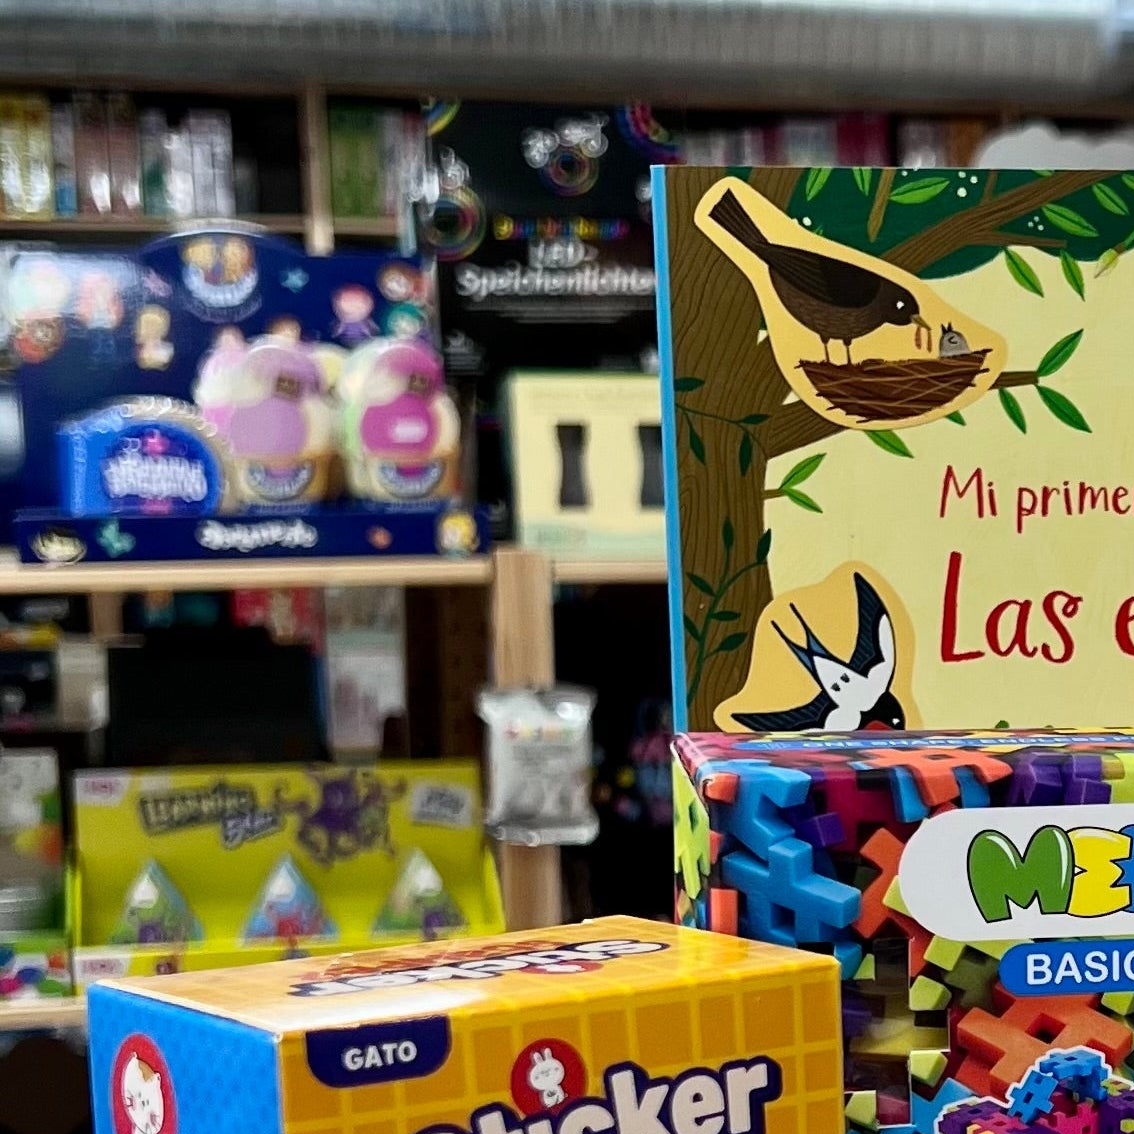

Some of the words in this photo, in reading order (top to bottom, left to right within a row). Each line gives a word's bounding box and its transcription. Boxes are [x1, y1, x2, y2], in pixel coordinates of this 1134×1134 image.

[939, 464, 998, 519] Mi
[941, 550, 1082, 663] Las
[343, 1040, 417, 1072] GATO
